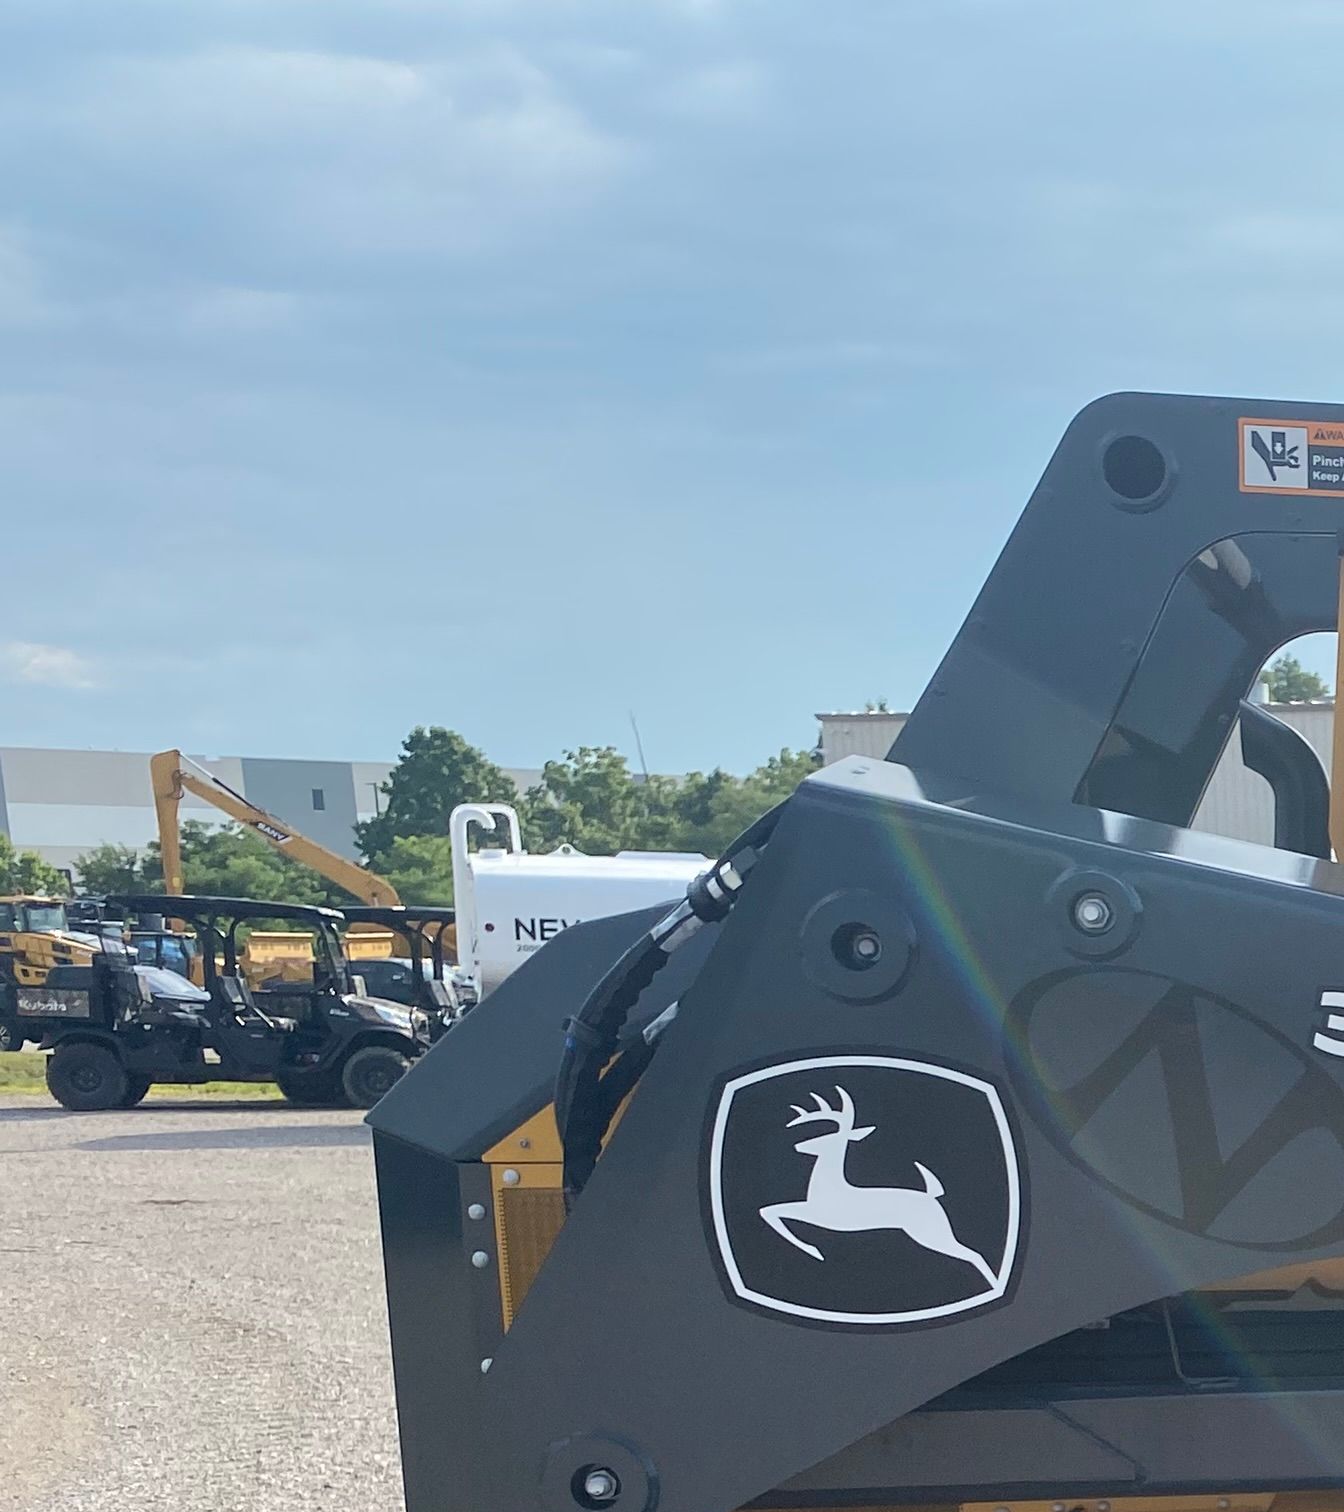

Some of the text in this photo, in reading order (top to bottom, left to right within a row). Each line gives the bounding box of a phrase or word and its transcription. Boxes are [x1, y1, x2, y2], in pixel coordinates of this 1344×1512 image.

[1312, 471, 1340, 483] Keep
[515, 918, 580, 940] NE
[18, 999, 67, 1012] Kubota
